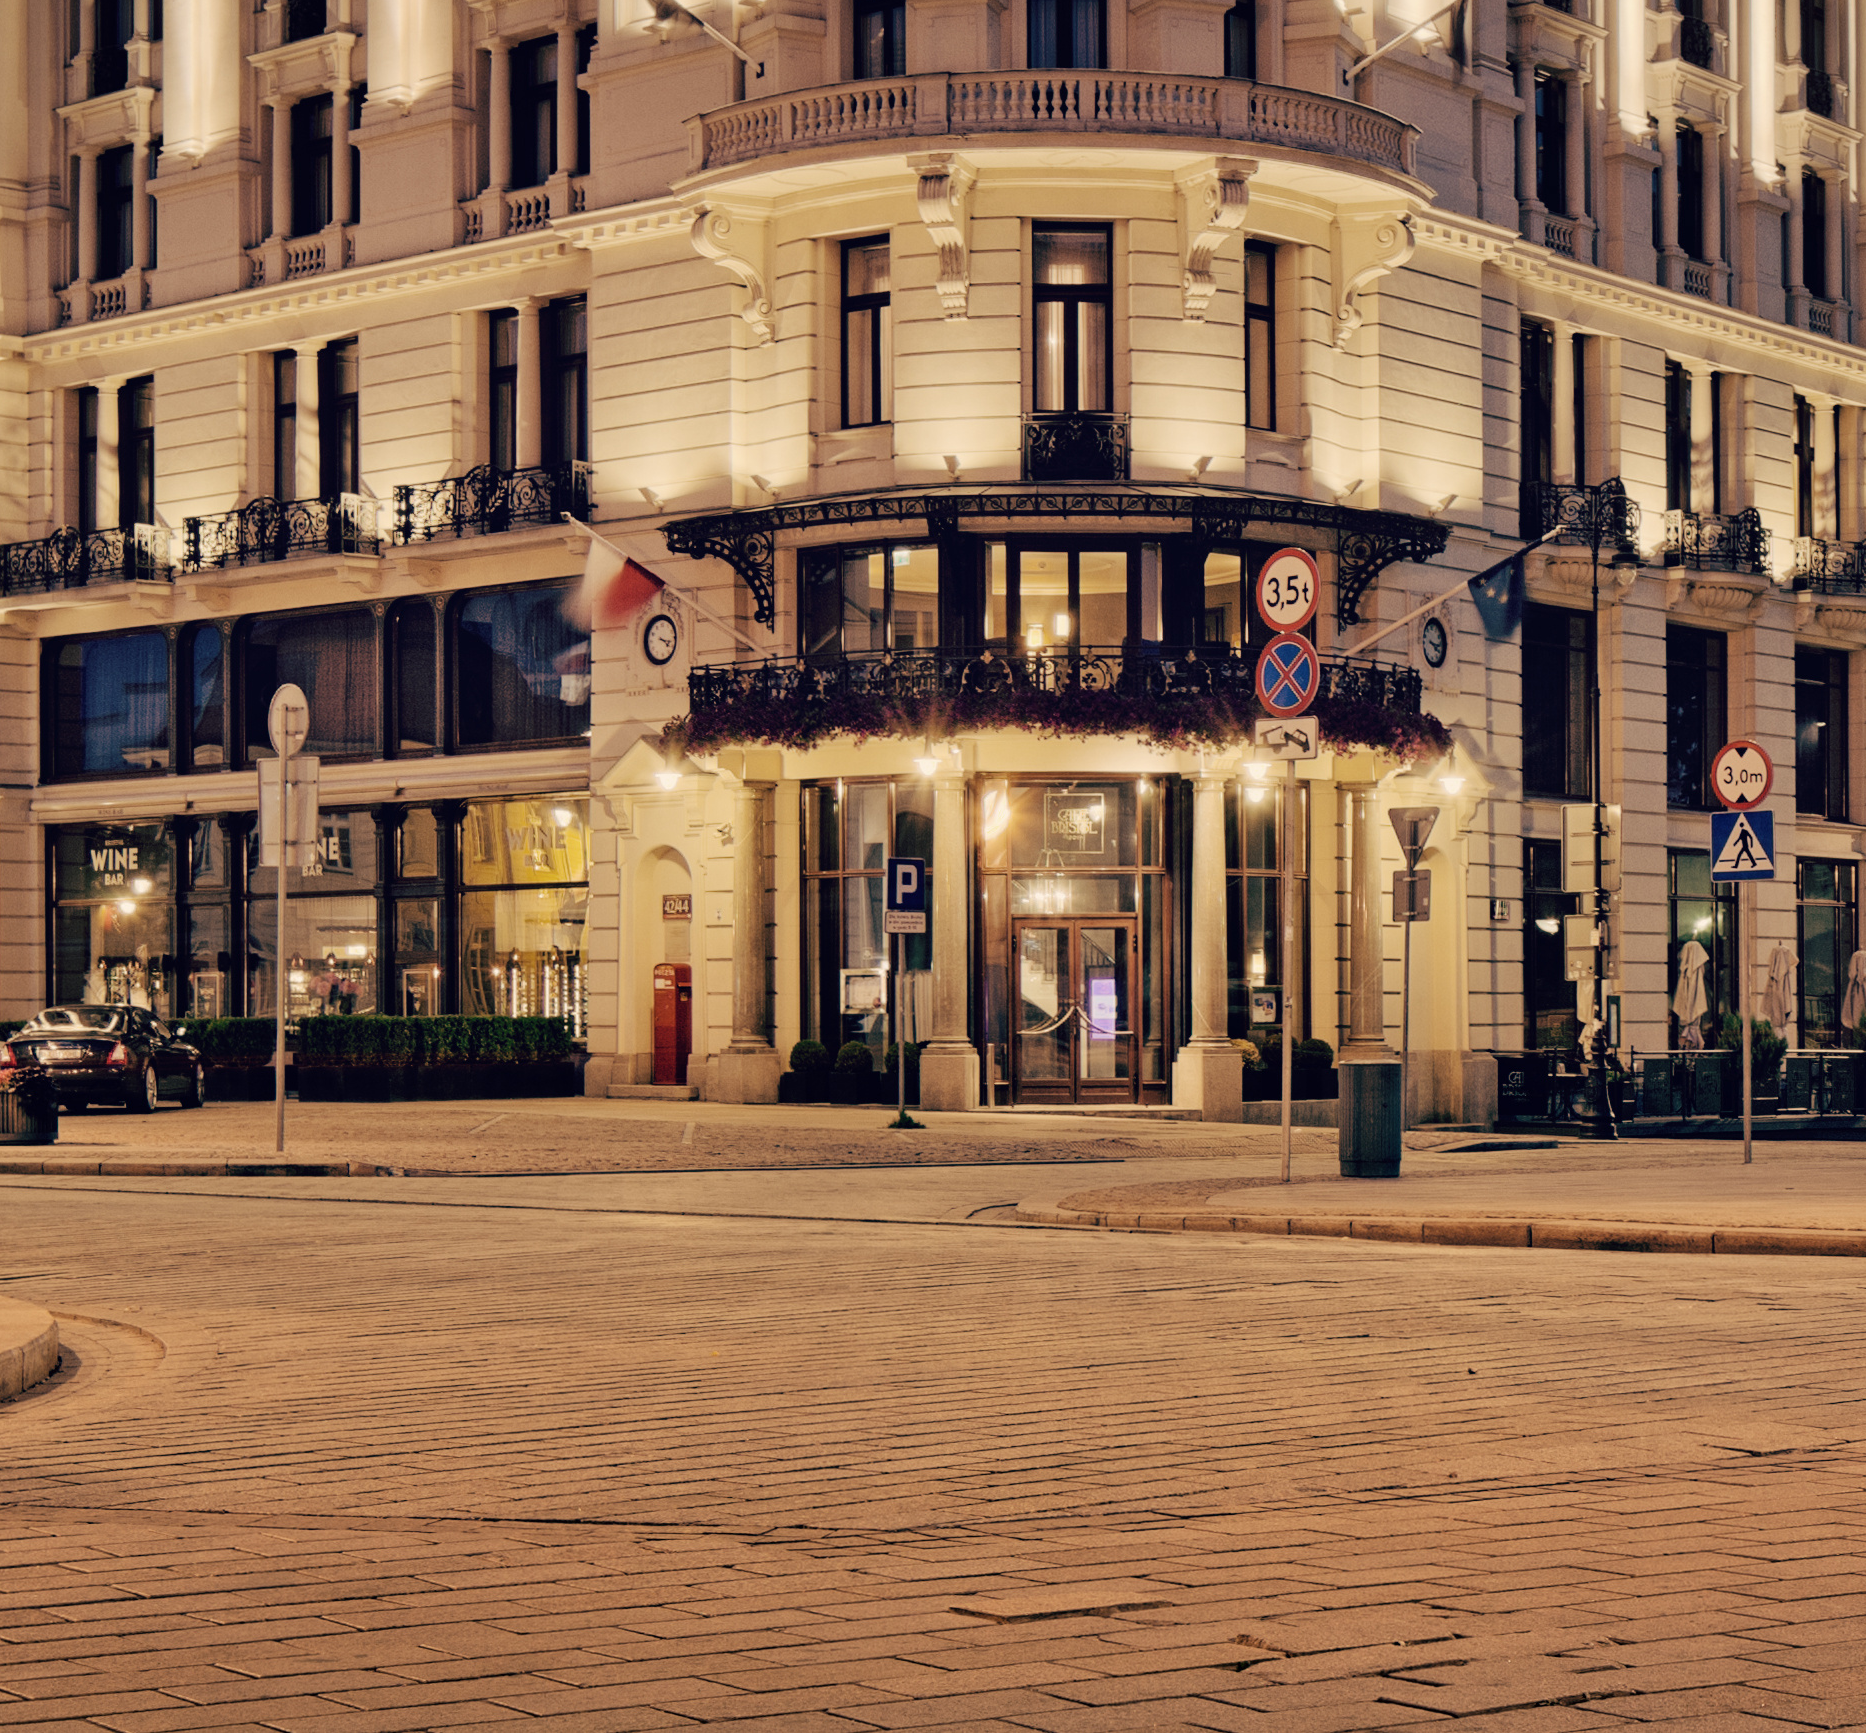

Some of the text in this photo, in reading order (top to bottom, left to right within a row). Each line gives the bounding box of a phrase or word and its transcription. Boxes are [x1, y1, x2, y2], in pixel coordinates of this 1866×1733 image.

[1723, 765, 1763, 786] 3,0m
[316, 836, 339, 860] NE
[506, 826, 566, 850] WINE
[90, 847, 139, 872] WINE
[301, 863, 323, 877] BAR
[104, 872, 124, 886] BAR
[896, 864, 918, 904] P
